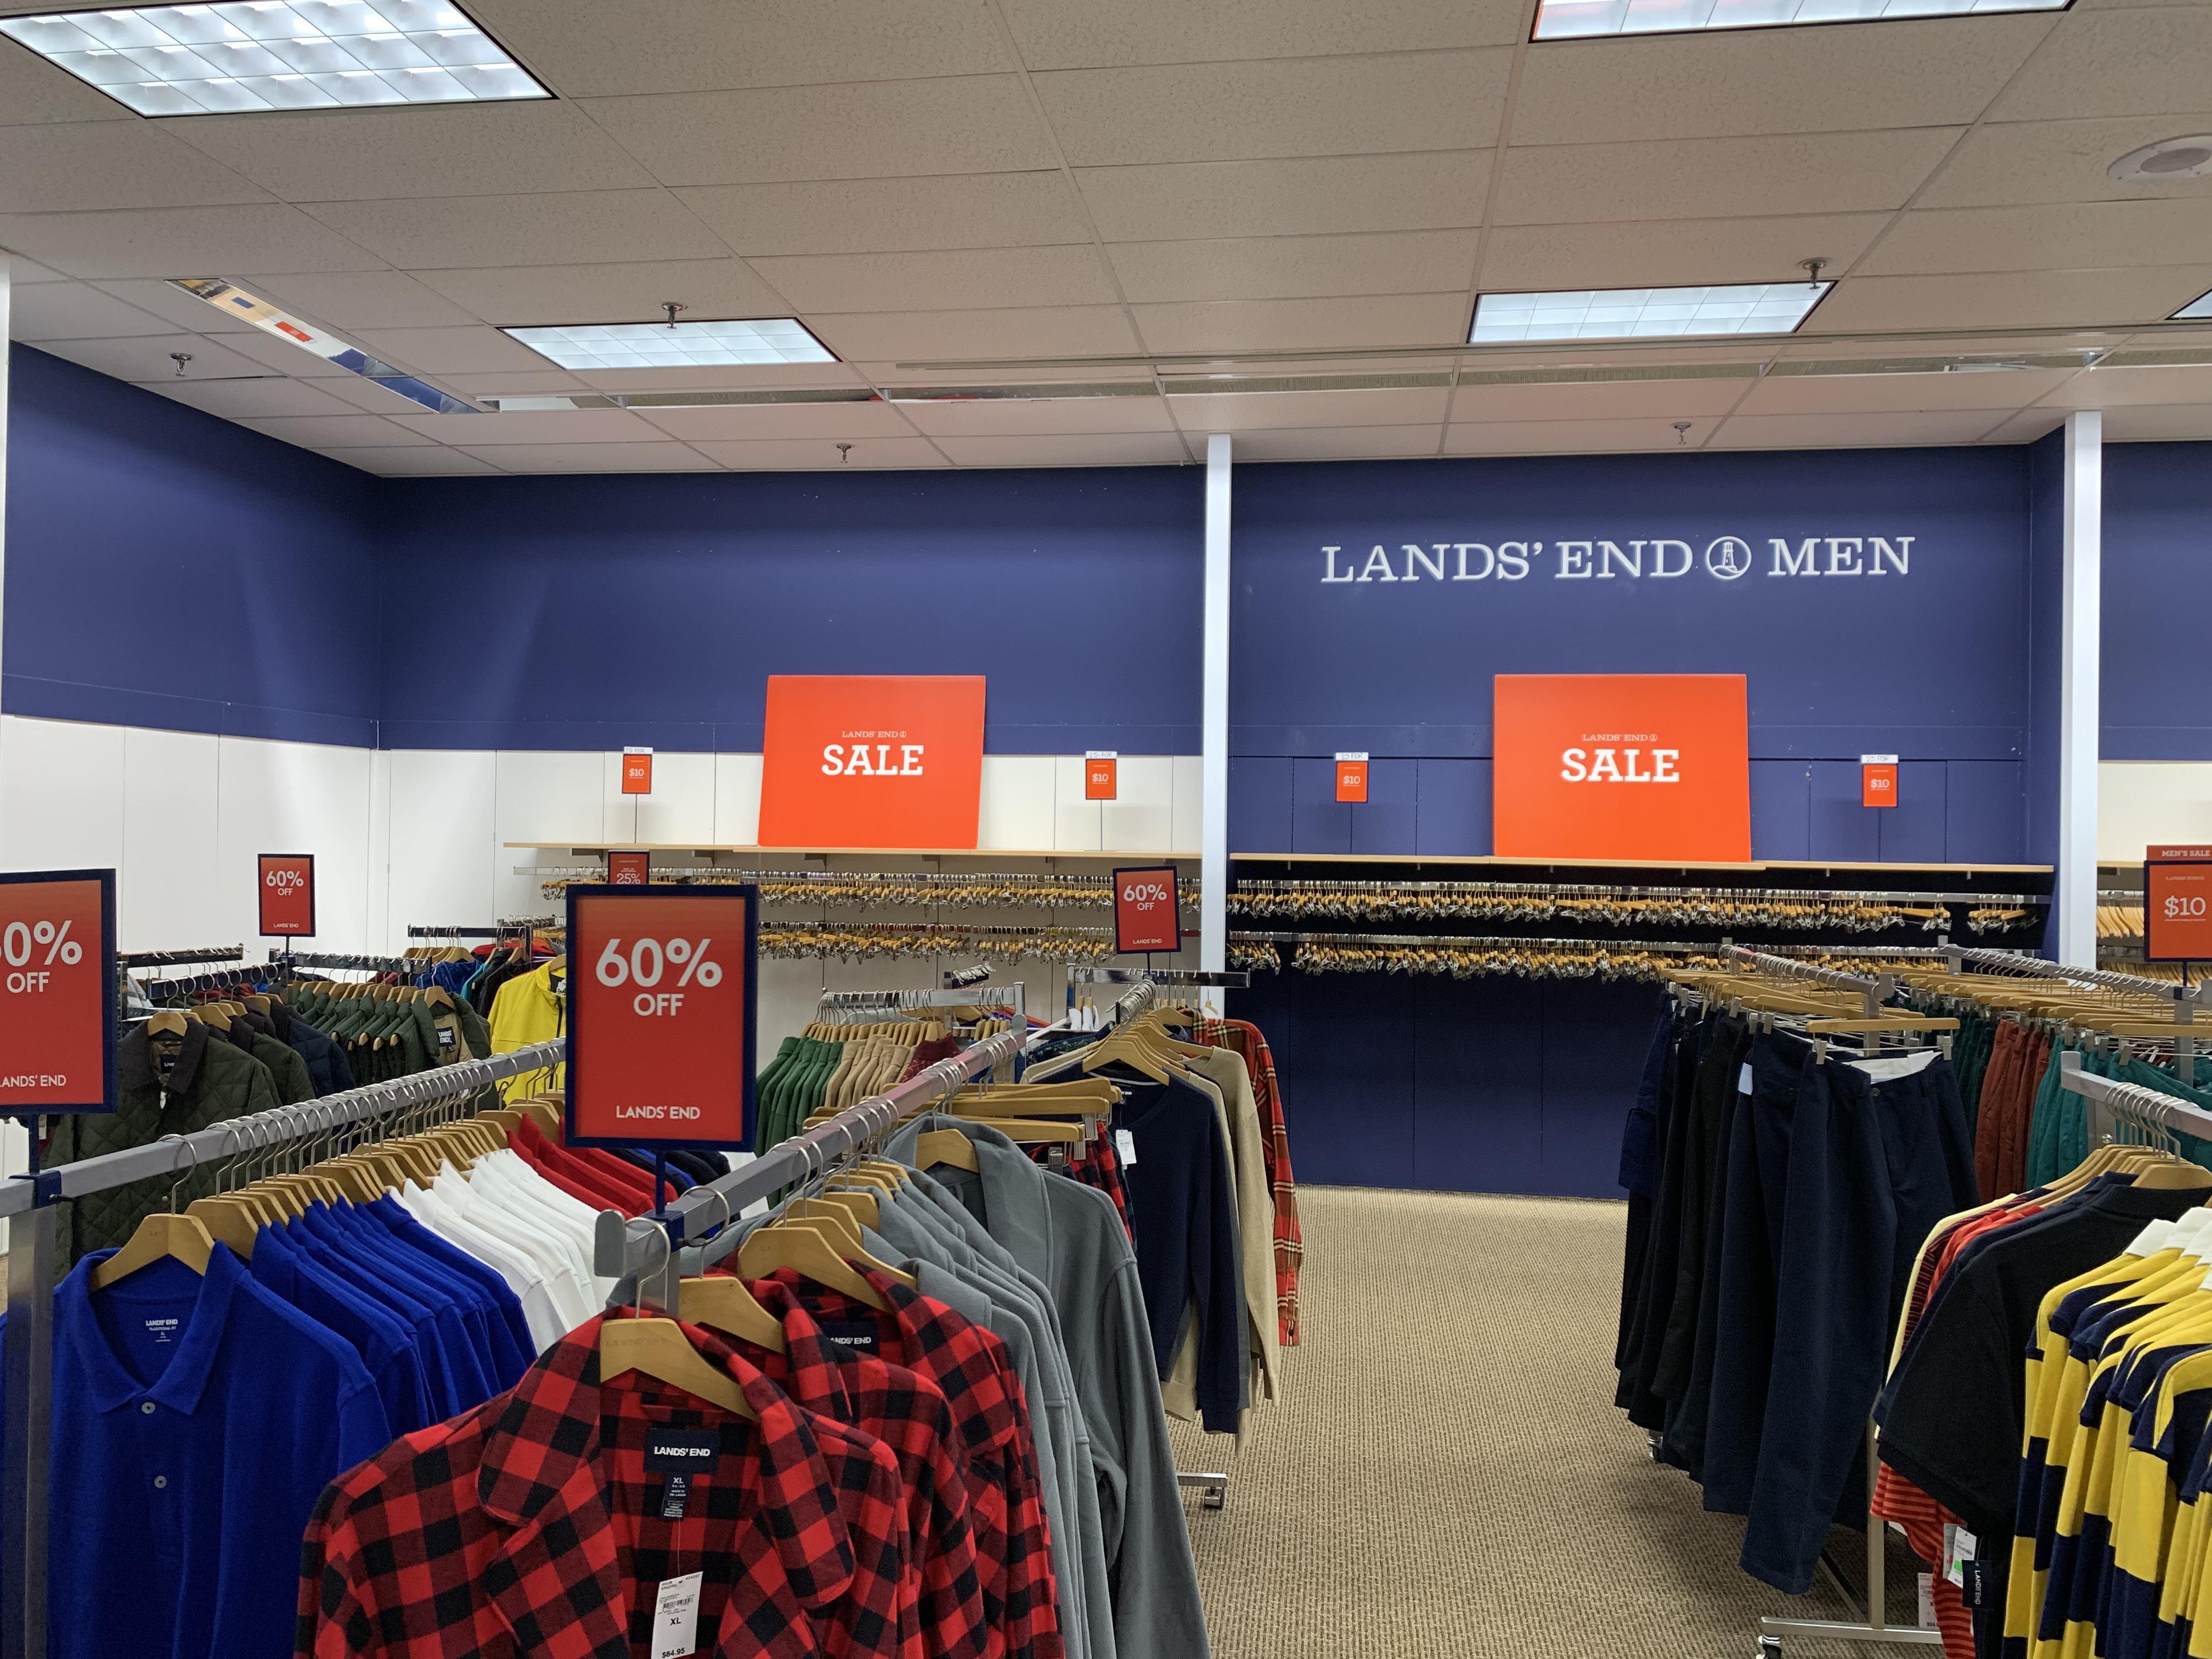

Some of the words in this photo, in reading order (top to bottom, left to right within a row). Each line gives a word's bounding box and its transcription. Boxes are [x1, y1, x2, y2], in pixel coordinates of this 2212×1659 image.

[1321, 541, 1543, 582] LANDS'
[1555, 539, 1694, 579] END
[1768, 537, 1916, 576] MEN
[821, 744, 924, 776] SALE
[1561, 748, 1680, 782] SALE
[629, 768, 645, 777] $10
[1092, 772, 1109, 782] $10
[1343, 775, 1361, 785] $10
[1871, 778, 1890, 789] $10
[266, 870, 304, 887] 60%
[616, 873, 641, 884] 25%
[278, 888, 293, 896] OFF
[1124, 884, 1167, 901] 60%
[1137, 902, 1155, 911] OFF
[2164, 895, 2207, 918] $10
[0, 920, 82, 967] 0%
[596, 938, 723, 988] 60%
[7, 972, 50, 994] OFF
[633, 994, 684, 1016] OFF
[0, 1075, 38, 1088] ANDS'
[40, 1075, 66, 1087] END
[616, 1105, 668, 1119] LANDS'
[669, 1106, 701, 1120] END
[654, 1446, 689, 1456] LANDS'
[689, 1448, 710, 1457] END
[670, 1617, 681, 1626] XL
[662, 1647, 685, 1658] $64.95
